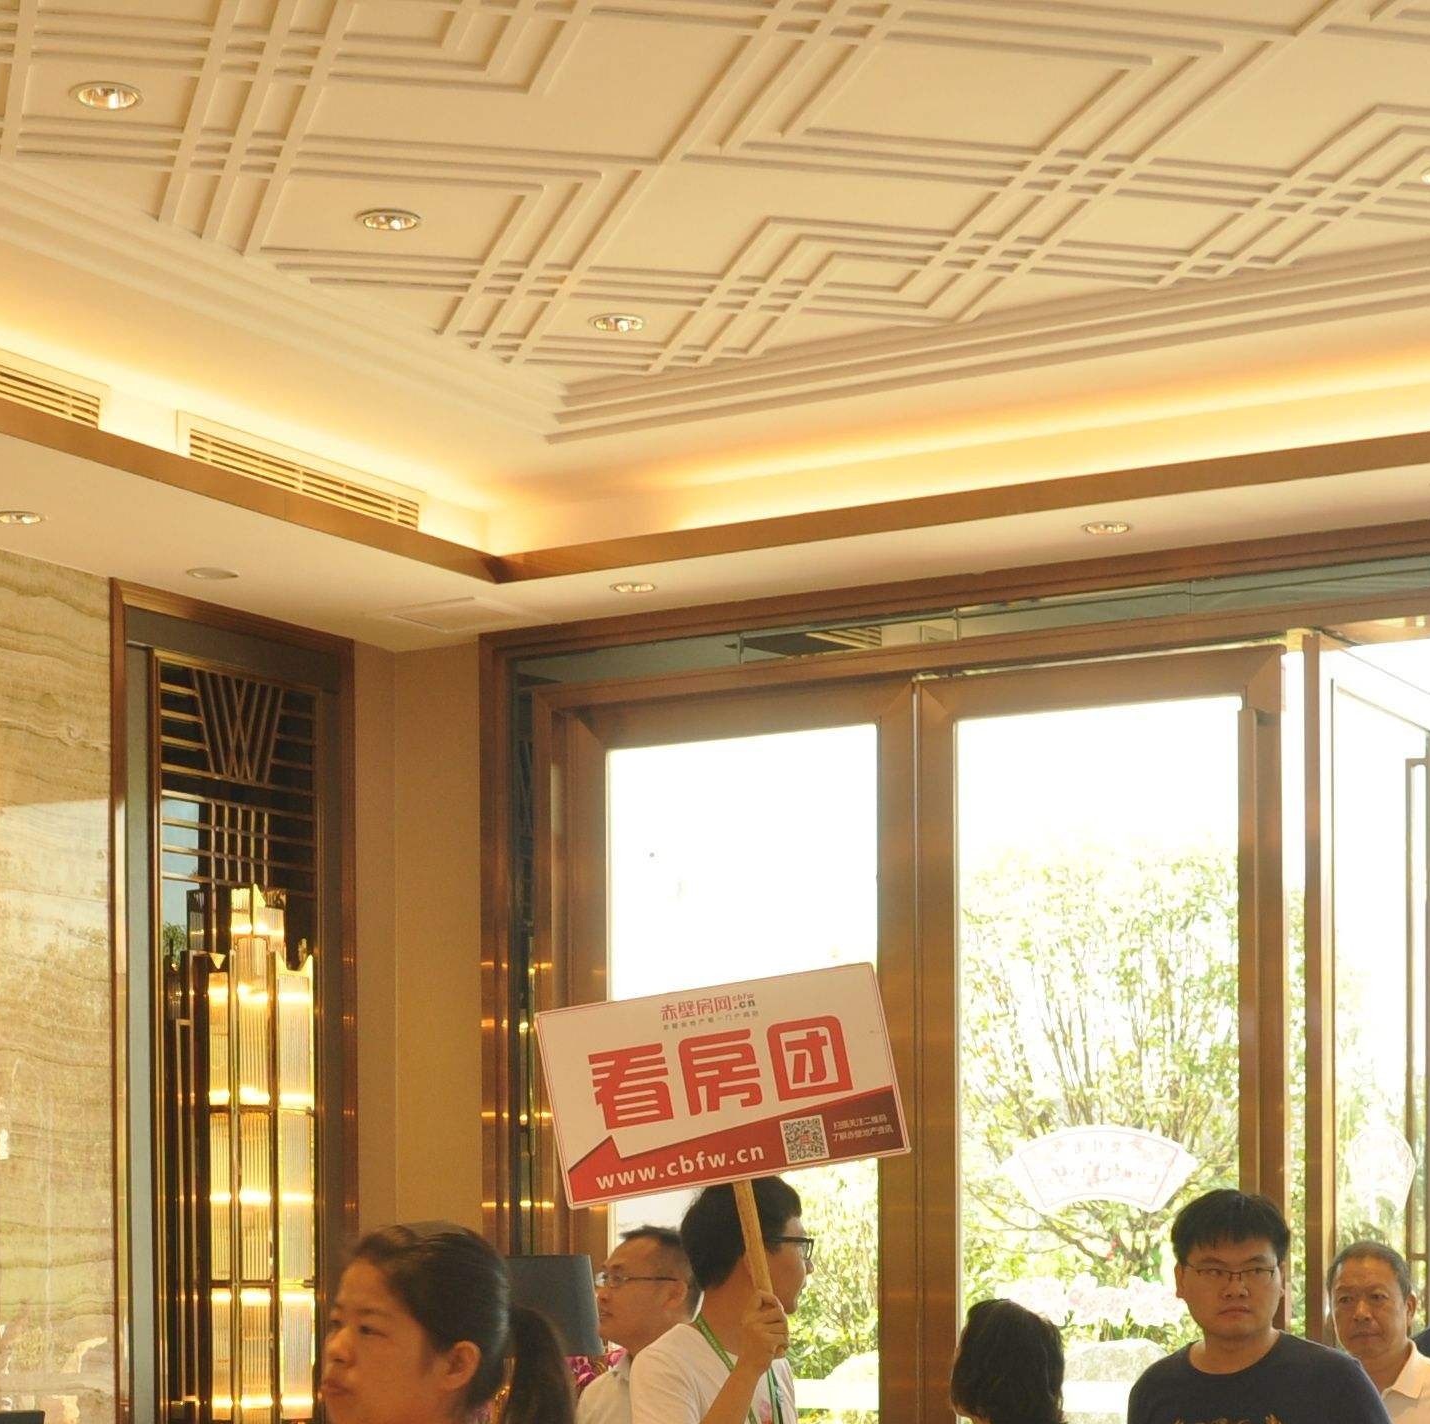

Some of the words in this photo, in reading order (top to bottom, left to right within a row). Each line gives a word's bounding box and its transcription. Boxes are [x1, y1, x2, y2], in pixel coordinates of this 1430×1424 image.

[660, 994, 733, 1021] 赤壁房网
[587, 1014, 854, 1131] 看房团
[595, 1145, 766, 1191] www.cbfw.cn
